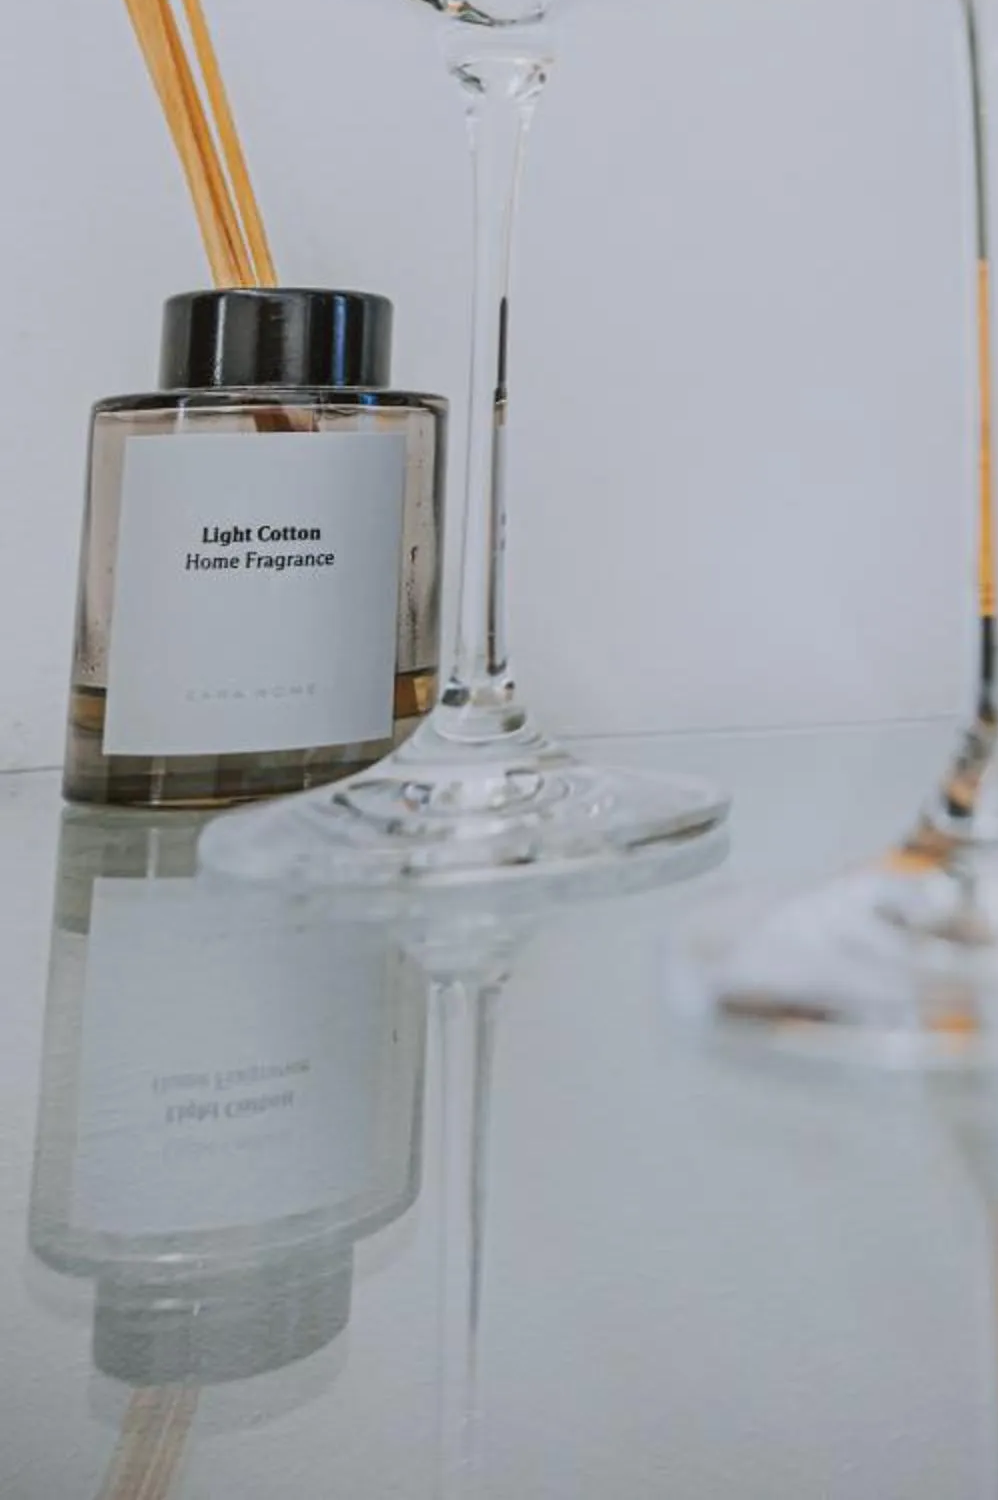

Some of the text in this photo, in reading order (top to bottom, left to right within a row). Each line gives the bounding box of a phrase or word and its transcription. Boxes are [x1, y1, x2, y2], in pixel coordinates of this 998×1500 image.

[202, 525, 321, 546] Light Cotton
[185, 551, 335, 571] Home Fragrance
